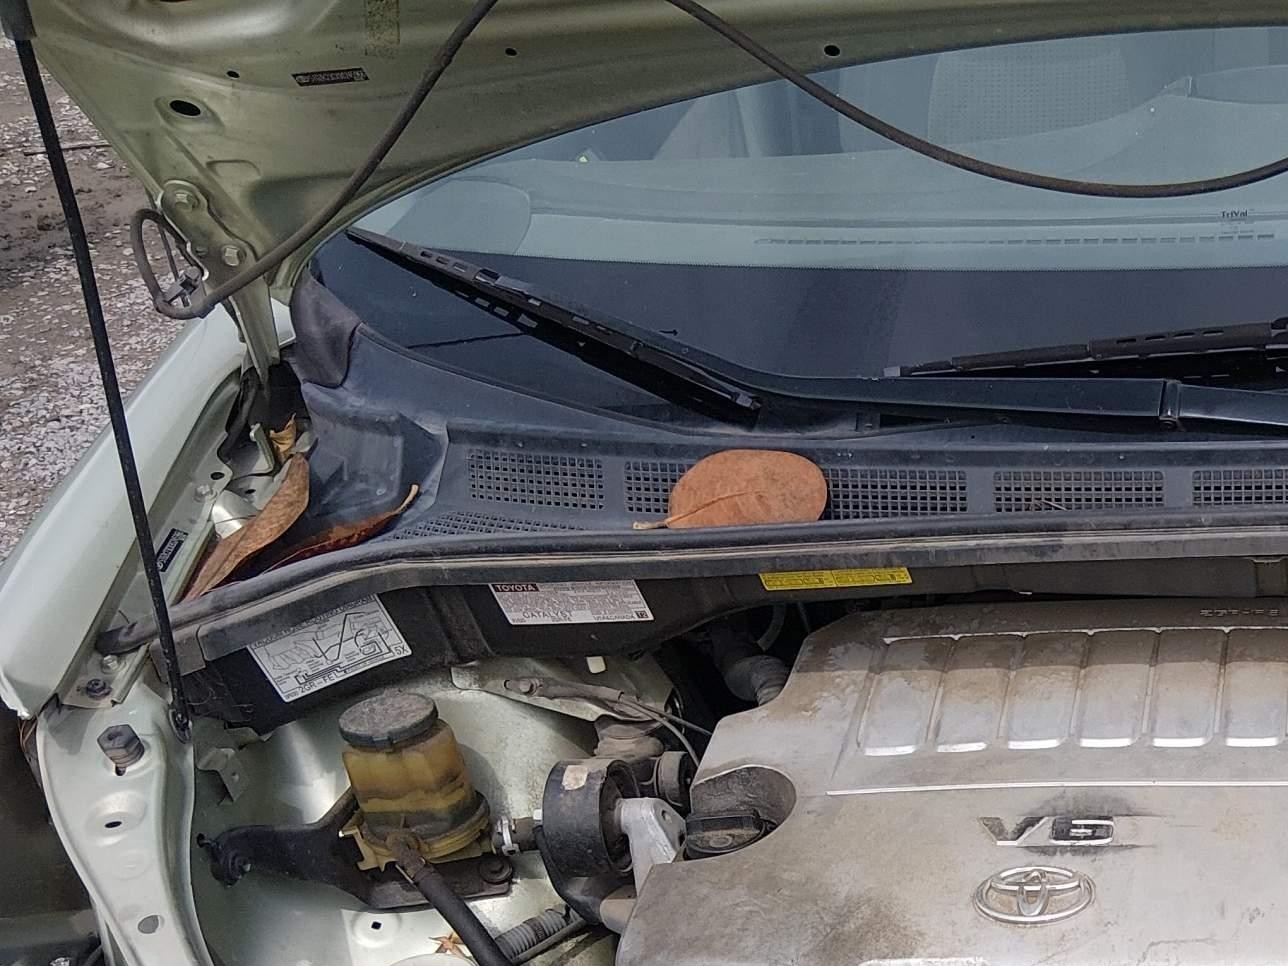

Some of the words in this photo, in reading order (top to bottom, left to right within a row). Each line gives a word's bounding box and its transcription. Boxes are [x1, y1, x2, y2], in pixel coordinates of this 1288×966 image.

[495, 584, 536, 592] TOYOTA
[522, 609, 574, 620] CATALYST
[395, 645, 409, 656] 5X
[977, 816, 1114, 846] V6
